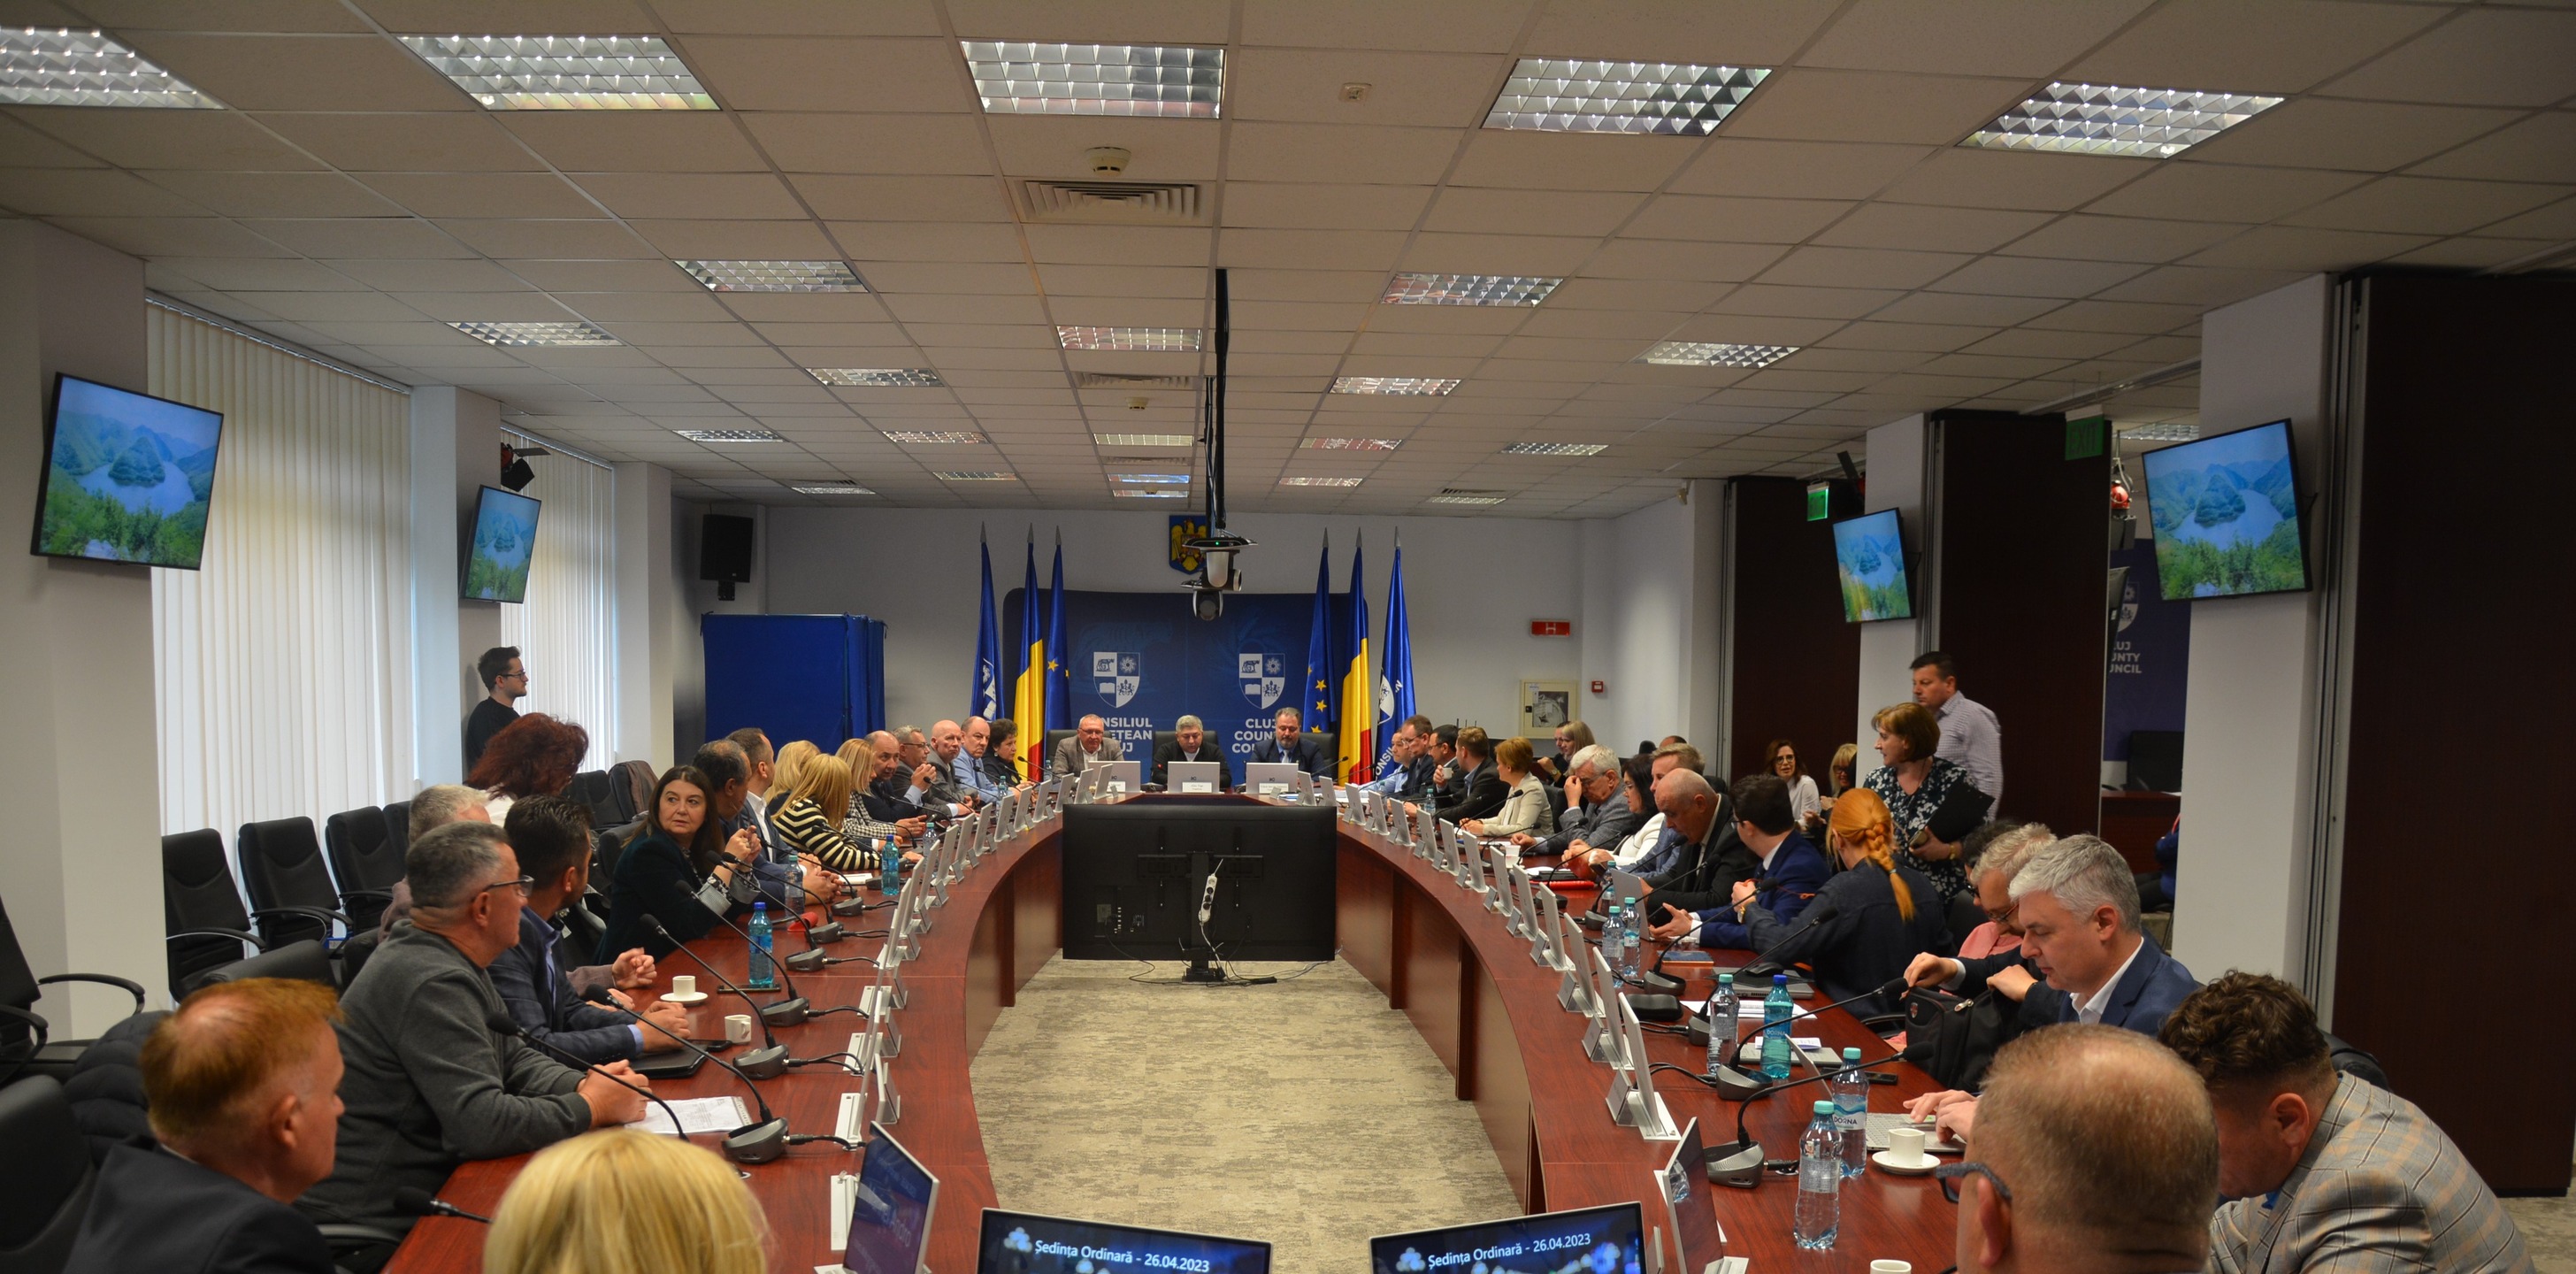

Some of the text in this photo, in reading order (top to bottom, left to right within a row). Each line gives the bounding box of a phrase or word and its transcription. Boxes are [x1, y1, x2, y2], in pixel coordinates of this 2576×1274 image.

[2112, 652, 2141, 663] UNTY
[2109, 664, 2142, 674] UNCIL
[1101, 717, 1154, 728] NSILIUL
[1109, 729, 1153, 742] EȚEAN
[1833, 1116, 1858, 1124] DORNA
[1034, 1239, 1078, 1258] Ședința
[1081, 1245, 1133, 1264] Ordinară
[1144, 1253, 1210, 1273] 26.04.2023
[1428, 1253, 1471, 1269] Ședința
[1474, 1242, 1522, 1262] Ordinară
[1532, 1232, 1591, 1254] 26.04.2023
